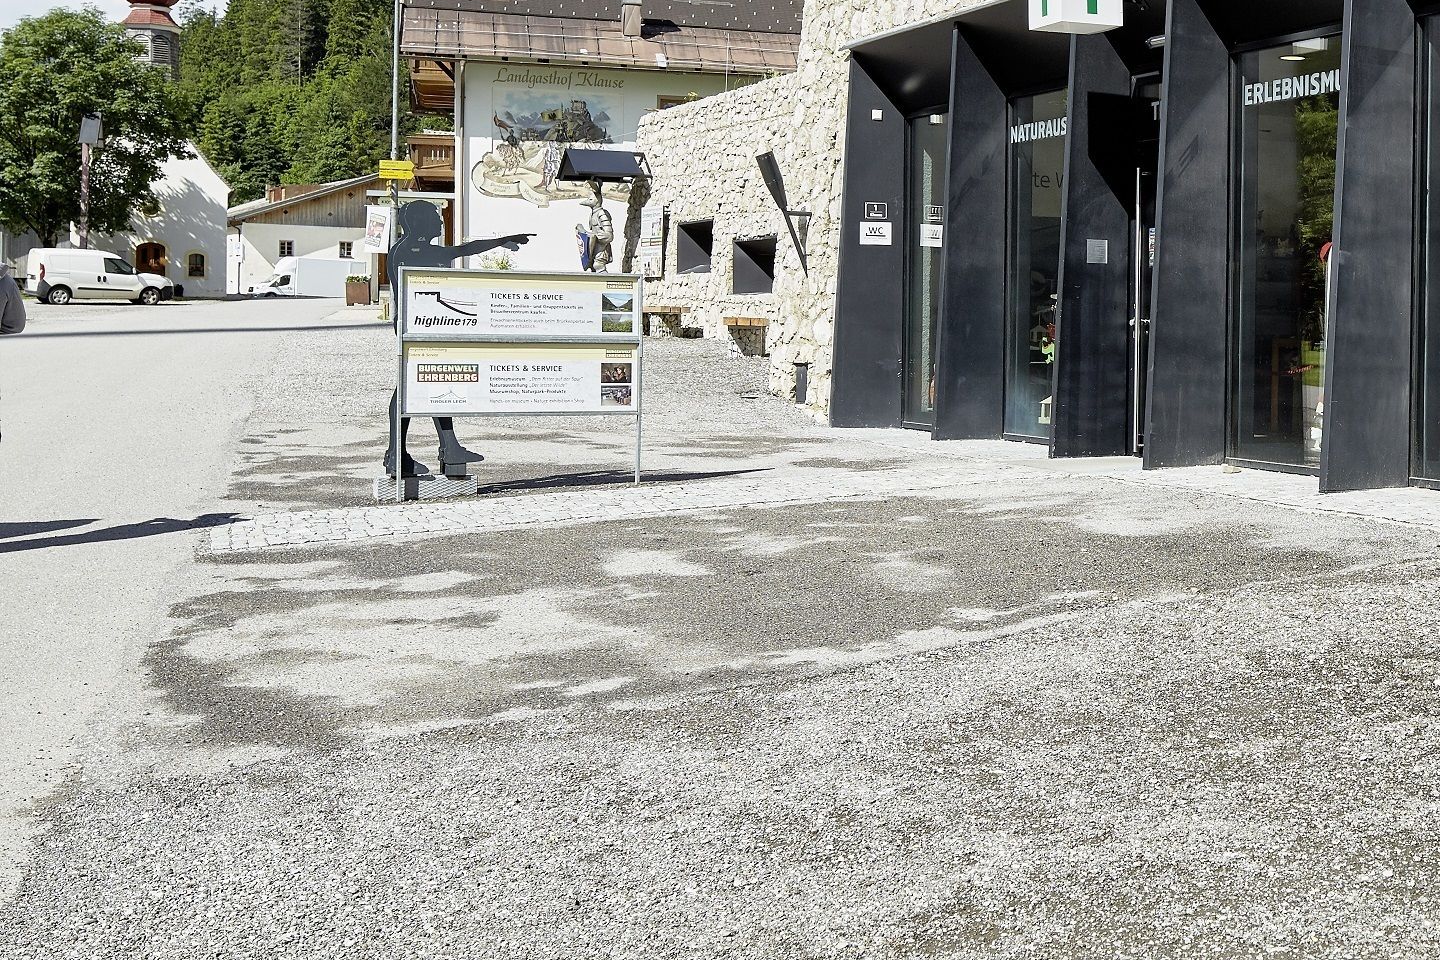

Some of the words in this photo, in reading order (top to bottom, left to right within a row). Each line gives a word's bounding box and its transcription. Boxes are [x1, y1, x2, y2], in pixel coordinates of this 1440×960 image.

[493, 68, 573, 90] Landgasthof
[576, 72, 625, 89] Klause
[1010, 117, 1067, 144] NATURAUS
[868, 227, 884, 235] WC
[418, 373, 478, 382] EHRENBERG
